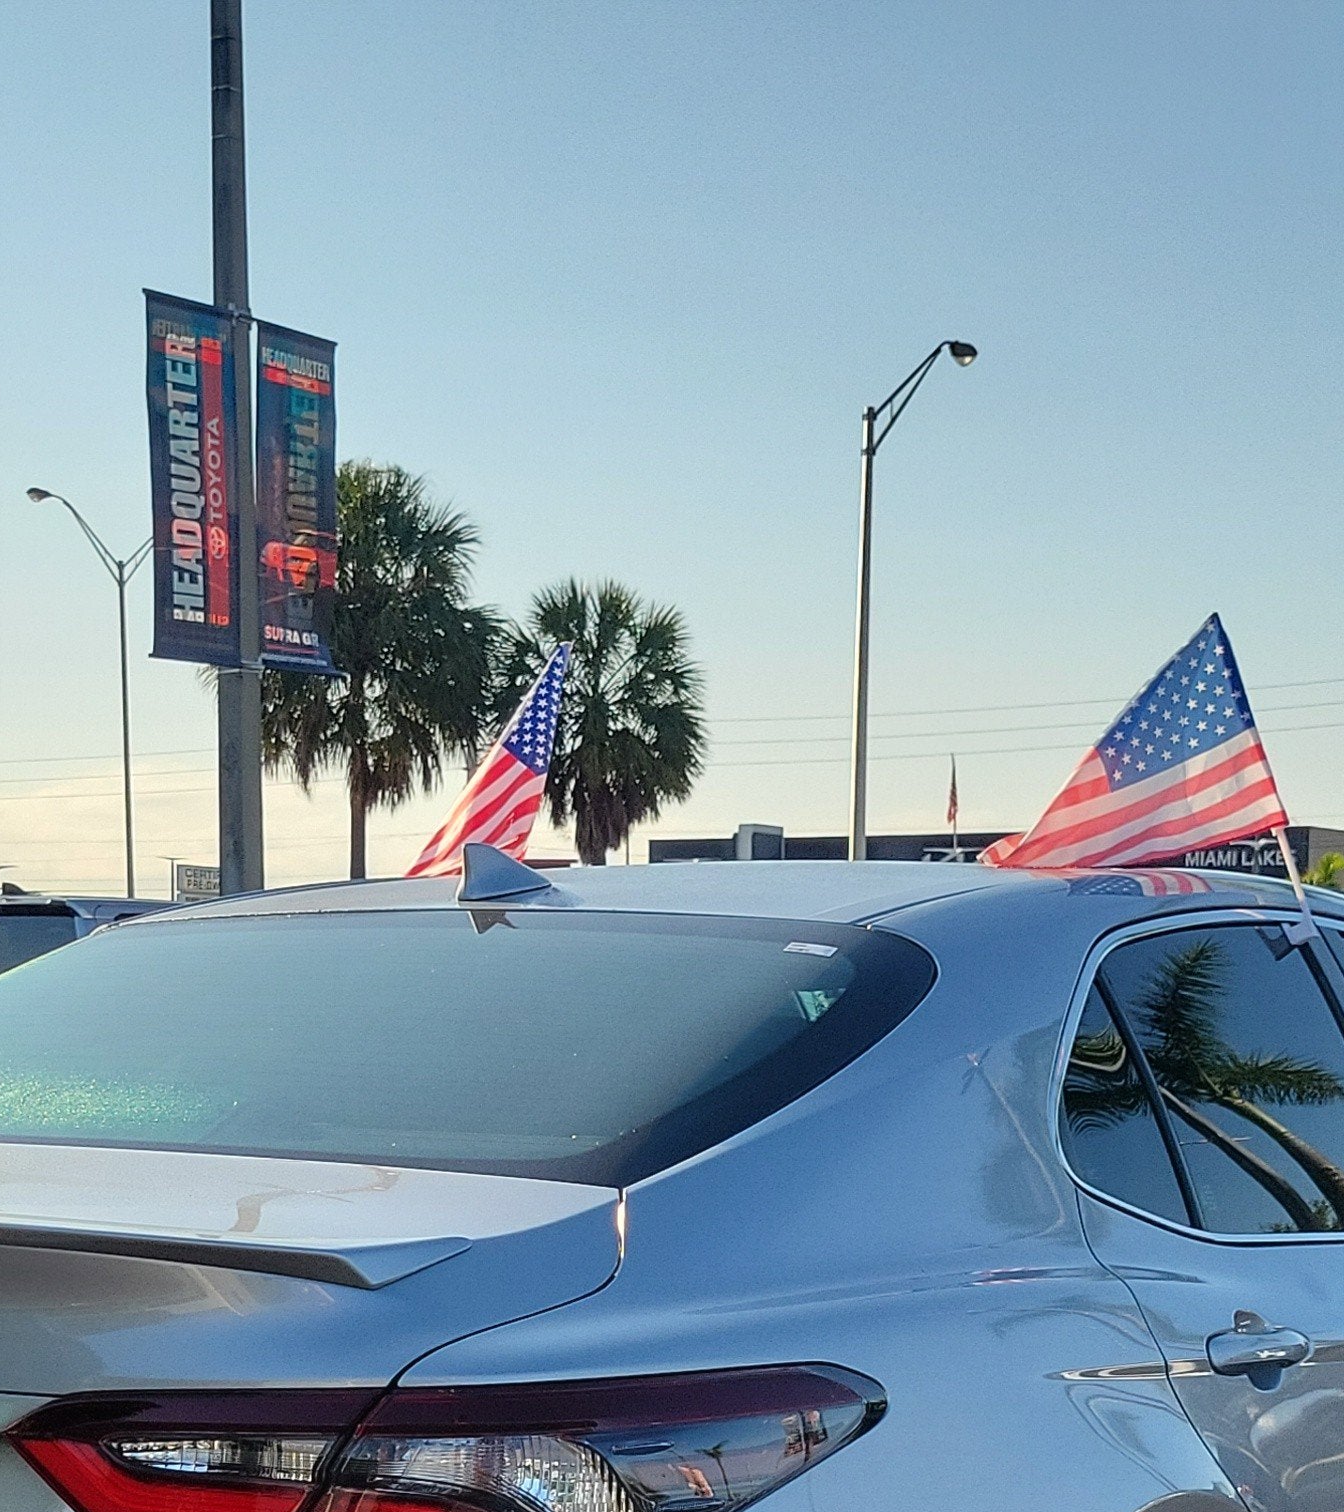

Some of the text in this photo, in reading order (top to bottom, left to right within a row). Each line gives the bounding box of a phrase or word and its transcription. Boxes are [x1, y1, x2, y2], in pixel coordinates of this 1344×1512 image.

[165, 334, 206, 624] HEADQUARTER
[206, 418, 224, 523] TOYOTA
[1185, 850, 1297, 867] MIAMI LAKE
